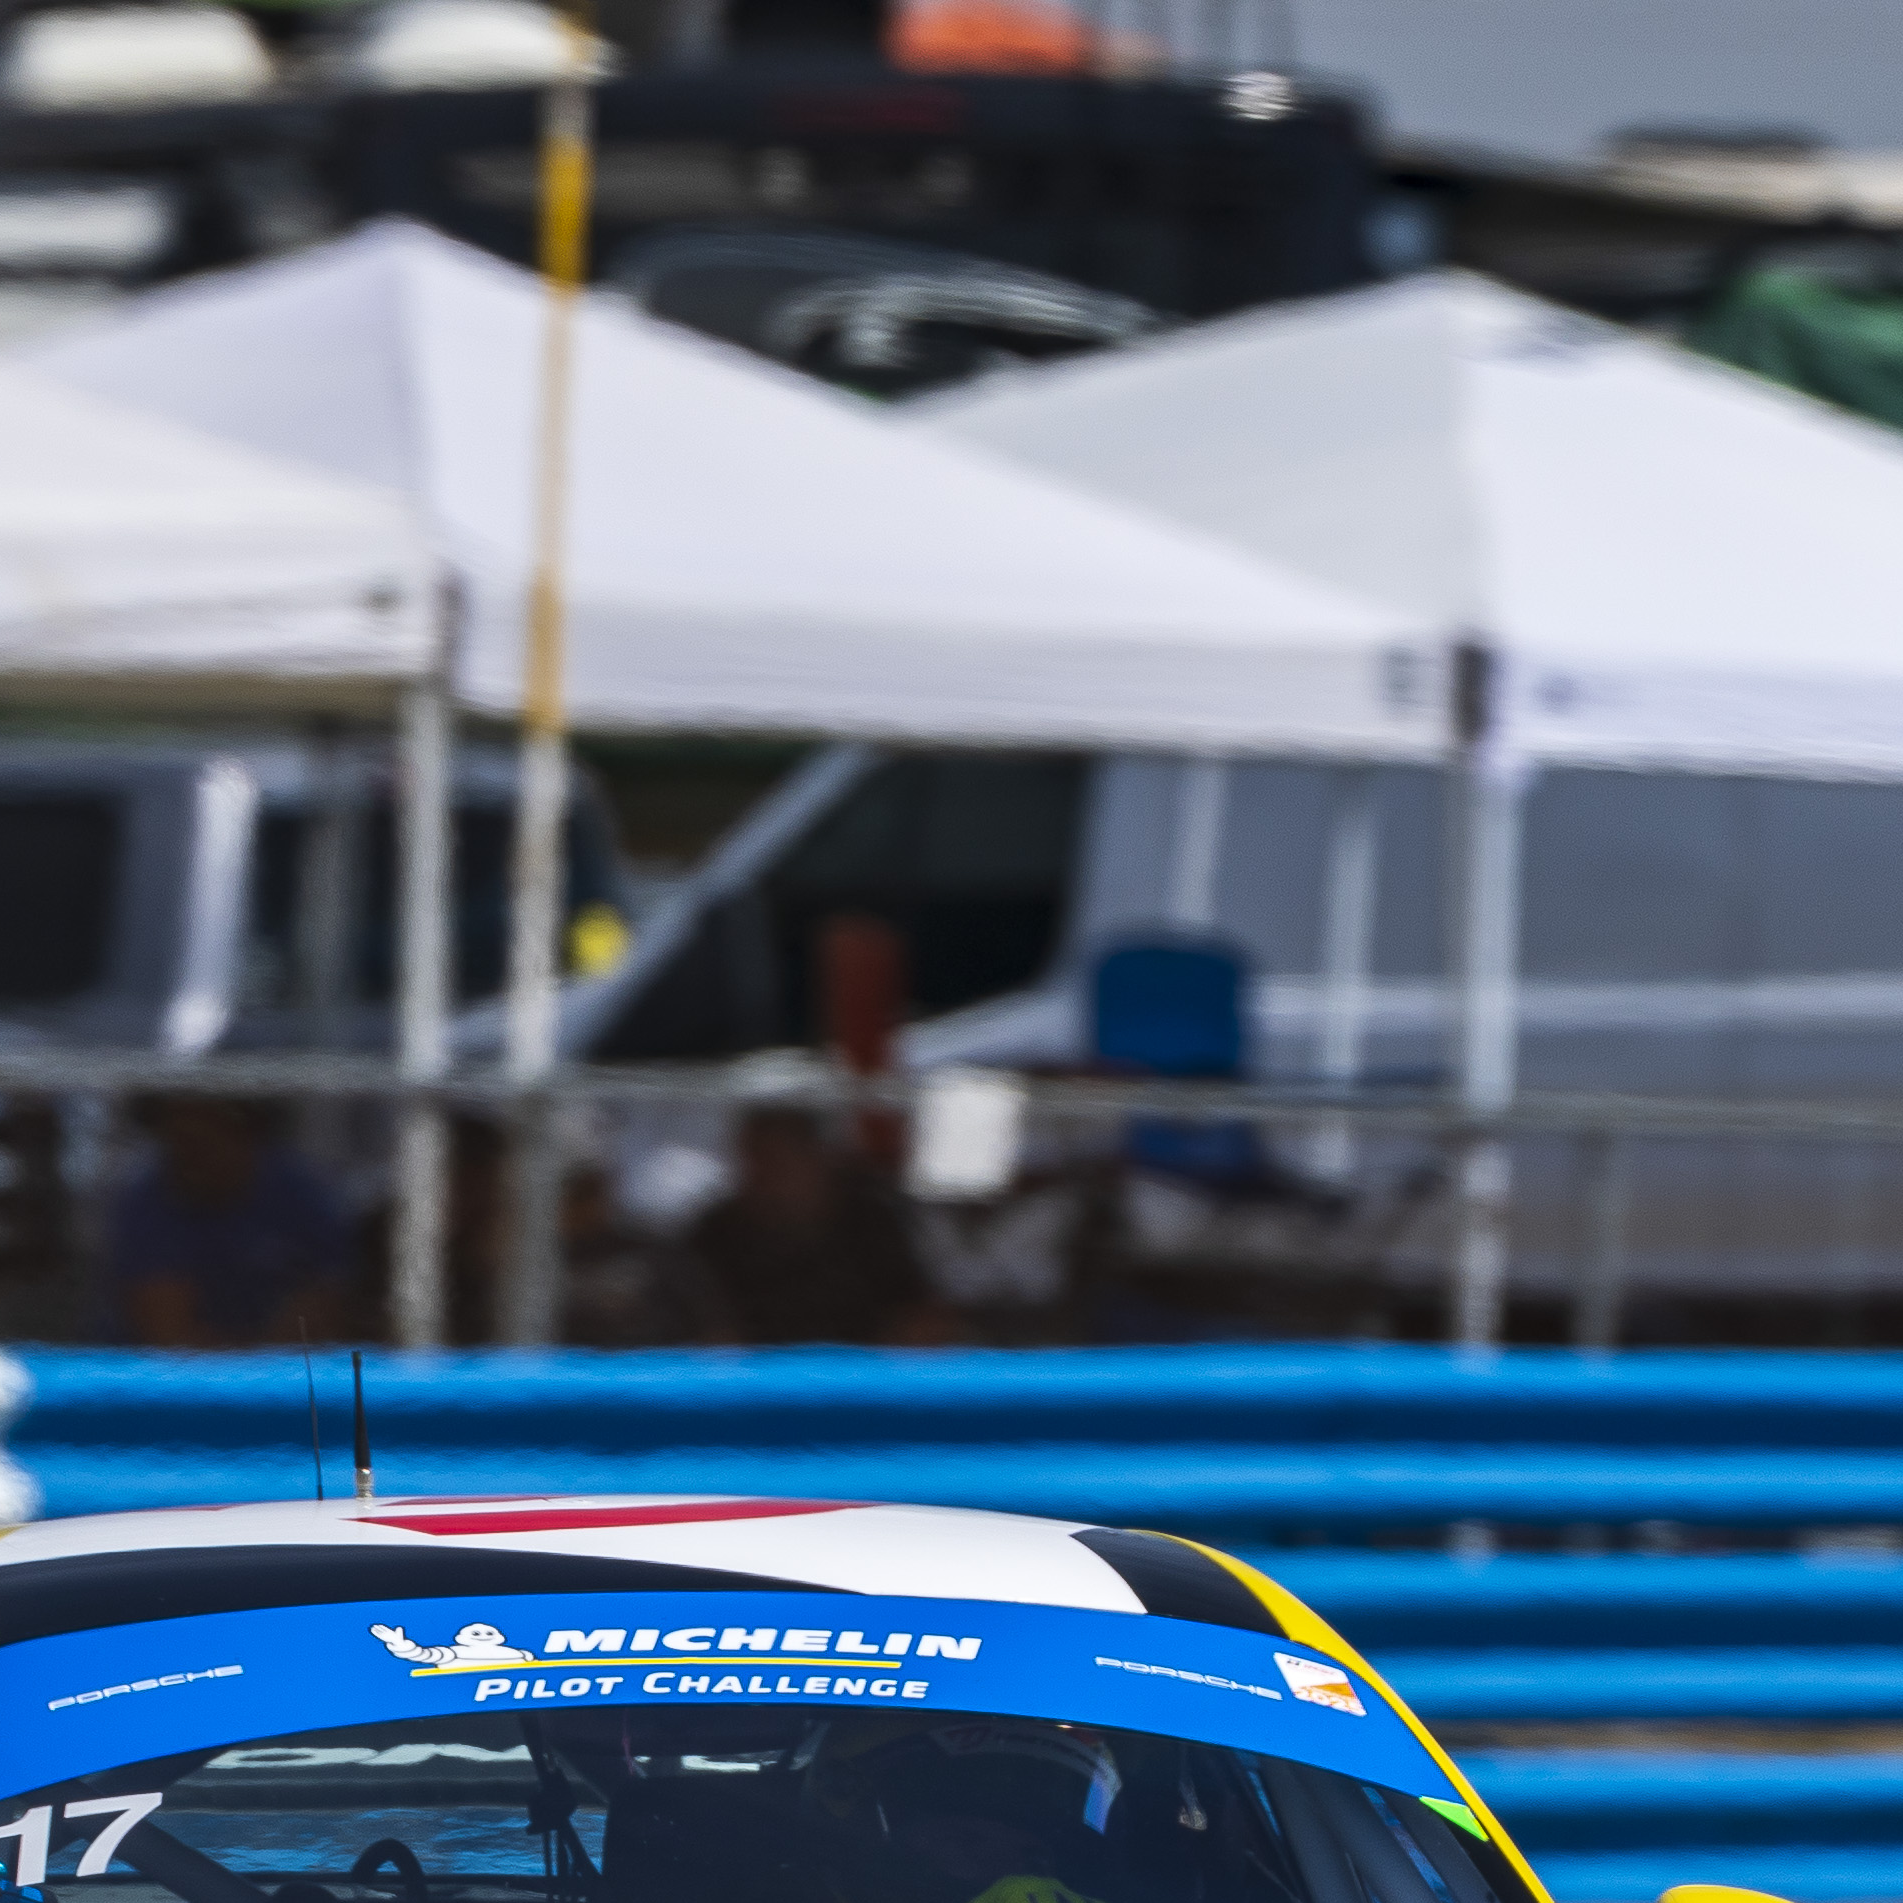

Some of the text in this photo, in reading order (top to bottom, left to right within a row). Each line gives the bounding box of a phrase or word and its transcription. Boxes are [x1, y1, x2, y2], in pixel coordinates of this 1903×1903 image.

[543, 1627, 983, 1660] MICHELIN
[48, 1665, 244, 1711] PORSCHE
[474, 1671, 929, 1701] PILOT CHALLENGE
[1096, 1656, 1283, 1701] PORSCHE
